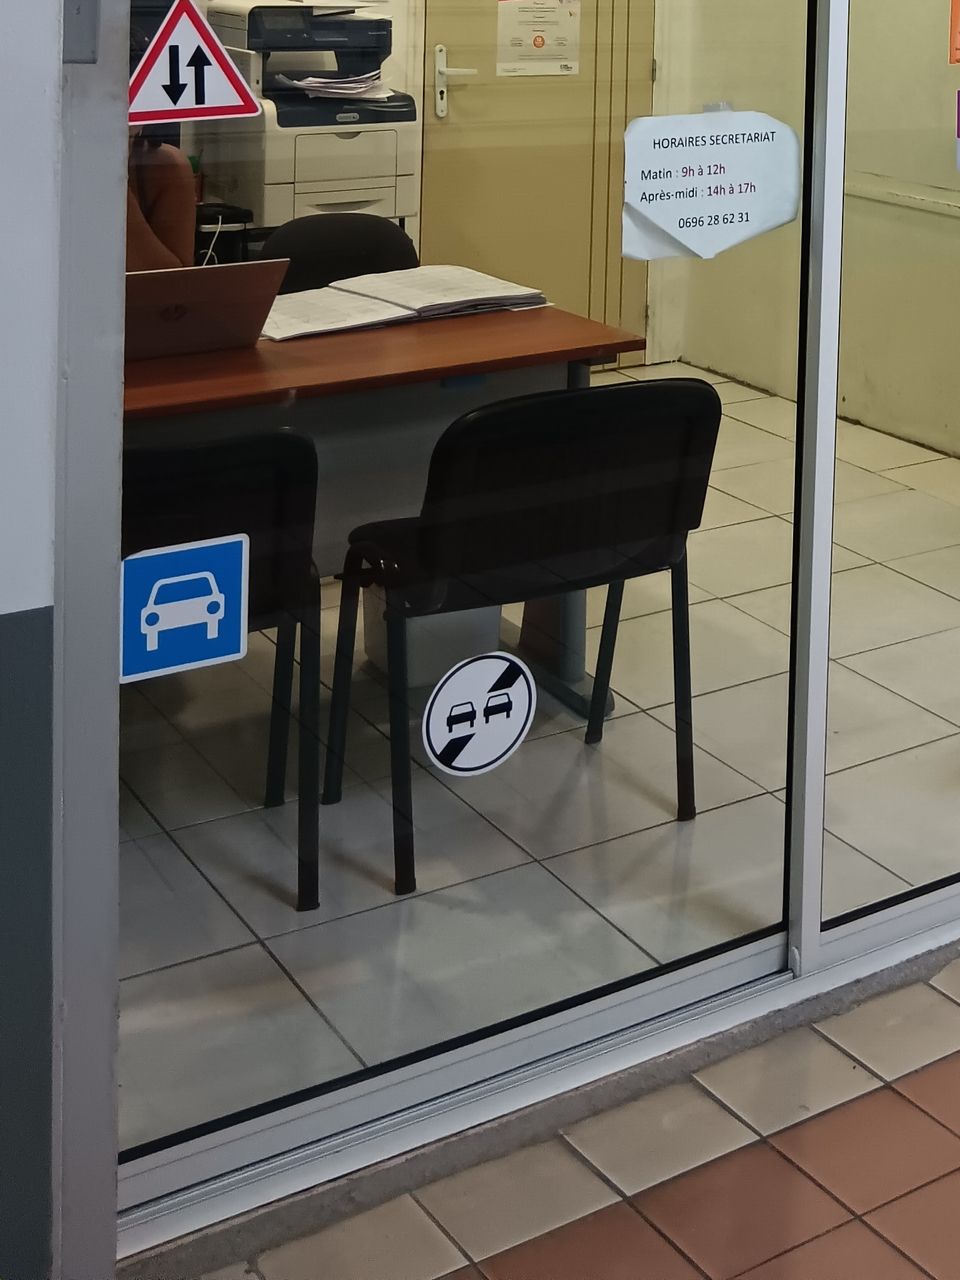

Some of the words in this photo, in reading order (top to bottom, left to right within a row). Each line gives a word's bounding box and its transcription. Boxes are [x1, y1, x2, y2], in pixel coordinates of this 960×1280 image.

[653, 135, 706, 150] HORAIRES
[709, 131, 776, 146] SECRETARIAT
[640, 169, 672, 181] Matin
[681, 166, 695, 178] 9h
[697, 165, 704, 176] à
[706, 163, 726, 175] 12h
[640, 187, 698, 203] Après-midi
[706, 184, 726, 197] 14h
[728, 183, 735, 195] à
[737, 182, 756, 195] 17h
[678, 217, 704, 229] 0696
[707, 215, 719, 226] 28
[722, 213, 735, 224] 62
[737, 212, 750, 223] 31
